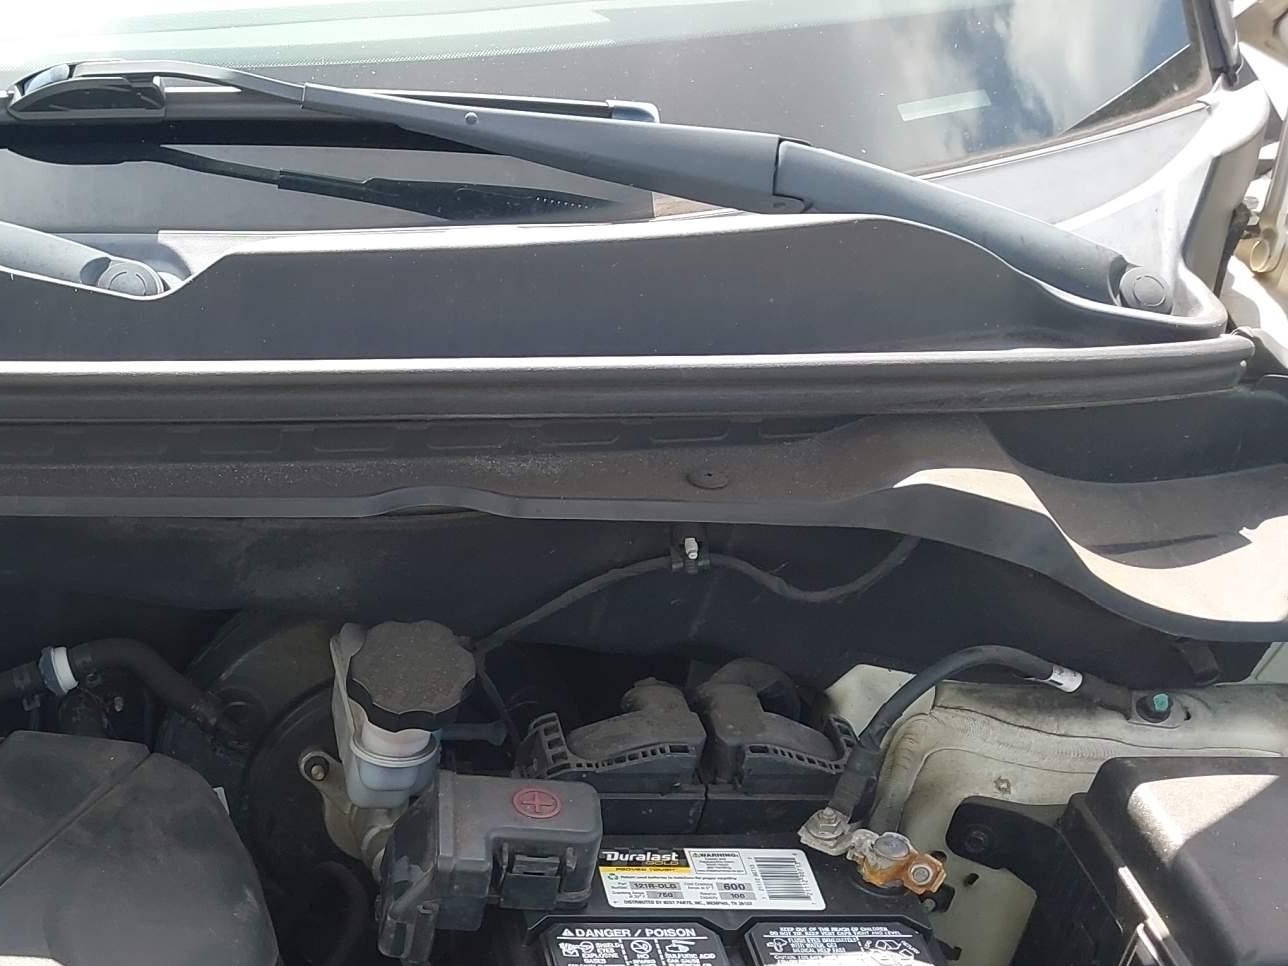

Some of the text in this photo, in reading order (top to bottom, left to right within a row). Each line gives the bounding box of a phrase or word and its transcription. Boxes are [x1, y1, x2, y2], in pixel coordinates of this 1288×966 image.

[601, 852, 680, 862] Duralast
[723, 883, 746, 891] 600
[575, 929, 631, 937] DANGER
[645, 929, 696, 937] POISON
